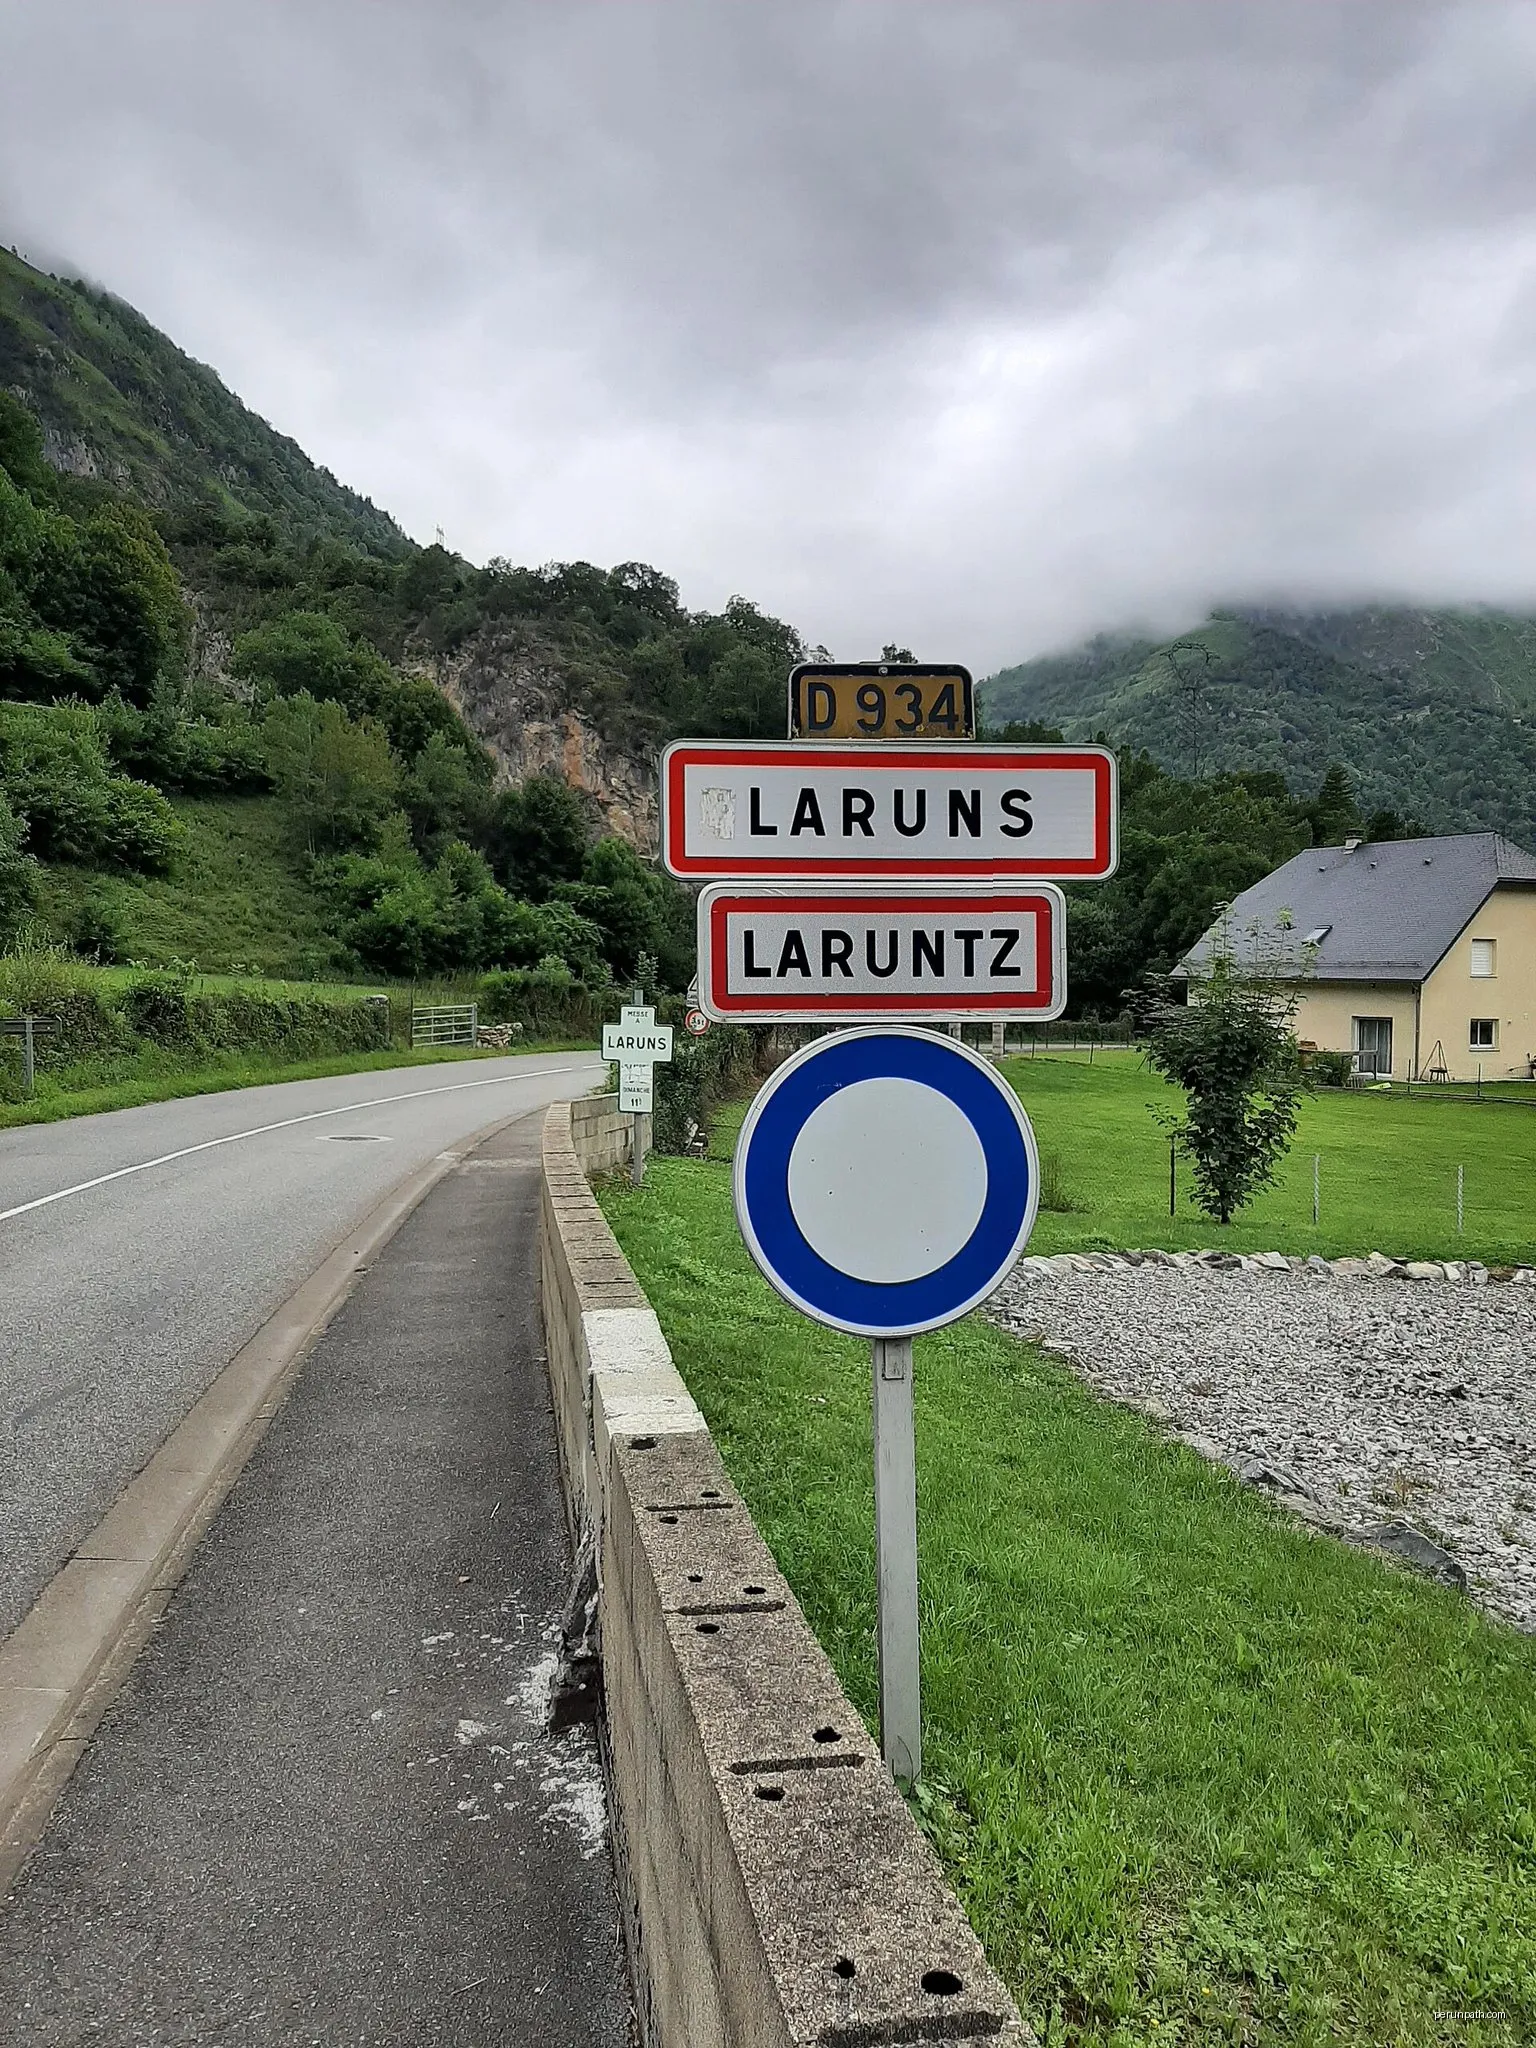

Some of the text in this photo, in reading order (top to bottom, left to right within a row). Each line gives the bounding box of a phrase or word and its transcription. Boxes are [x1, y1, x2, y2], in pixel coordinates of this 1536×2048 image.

[807, 682, 959, 732] D 934
[749, 787, 1034, 838] LARUNS
[743, 929, 1022, 978] LARUNTZ
[608, 1036, 666, 1050] LARUNS
